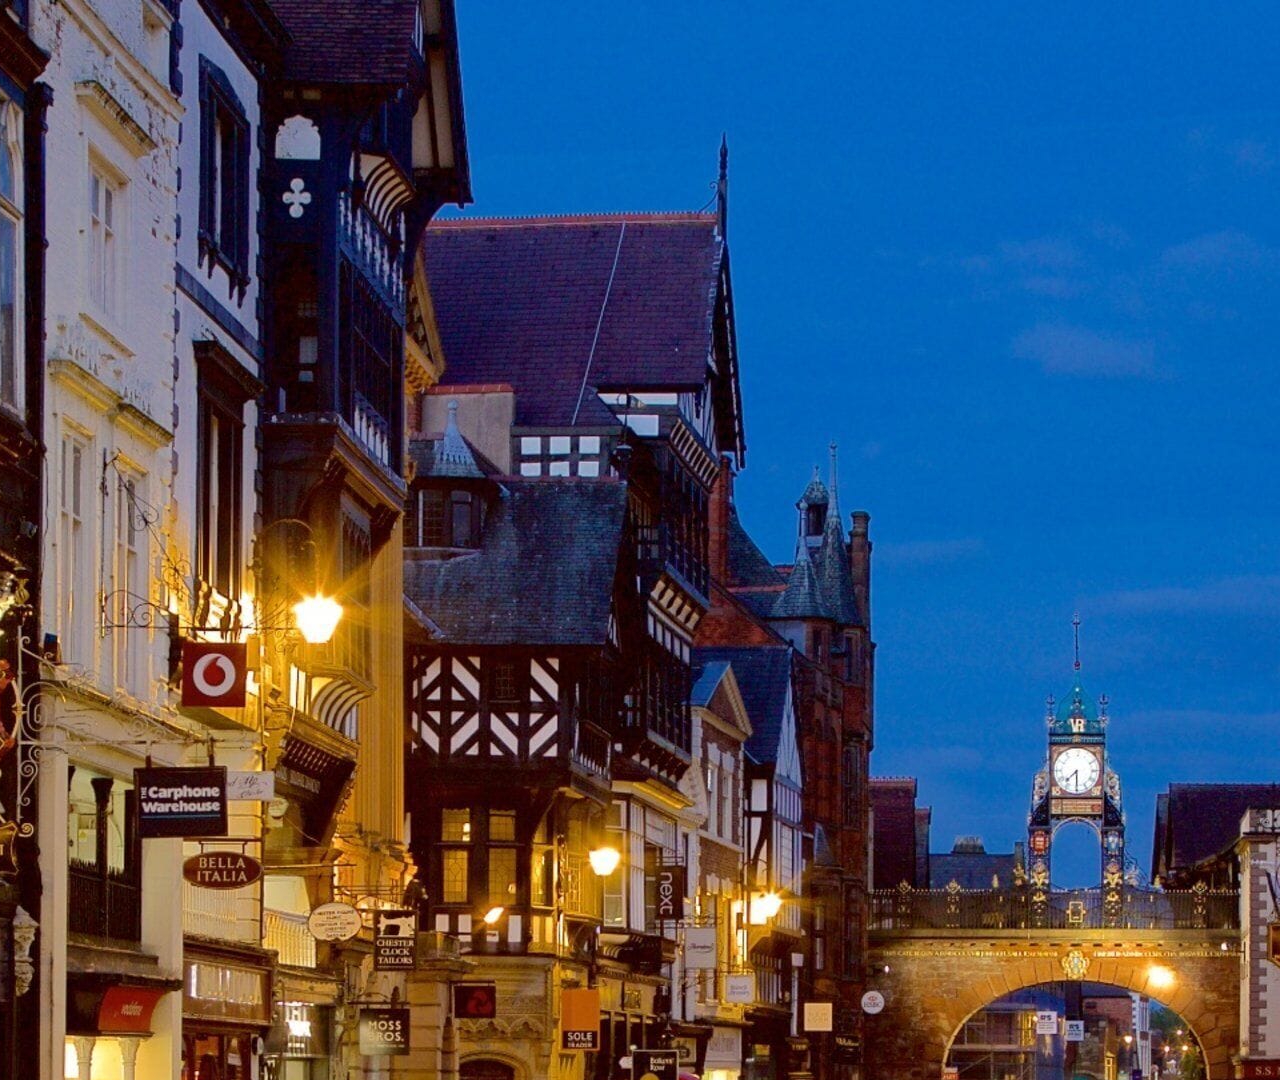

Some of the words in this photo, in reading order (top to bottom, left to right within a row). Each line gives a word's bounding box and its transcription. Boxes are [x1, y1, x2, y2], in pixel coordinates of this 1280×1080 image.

[149, 785, 220, 799] Carphone
[142, 801, 221, 813] Warehouse
[199, 857, 246, 868] BELLA
[197, 870, 248, 882] ITALIA
[660, 871, 673, 915] next
[376, 939, 414, 947] CHESTER
[377, 956, 413, 964] TAILORS
[368, 1021, 402, 1030] MOSS
[368, 1031, 405, 1042] BROS.
[567, 1031, 593, 1041] SOLE
[1255, 1066, 1273, 1076] S.S.
